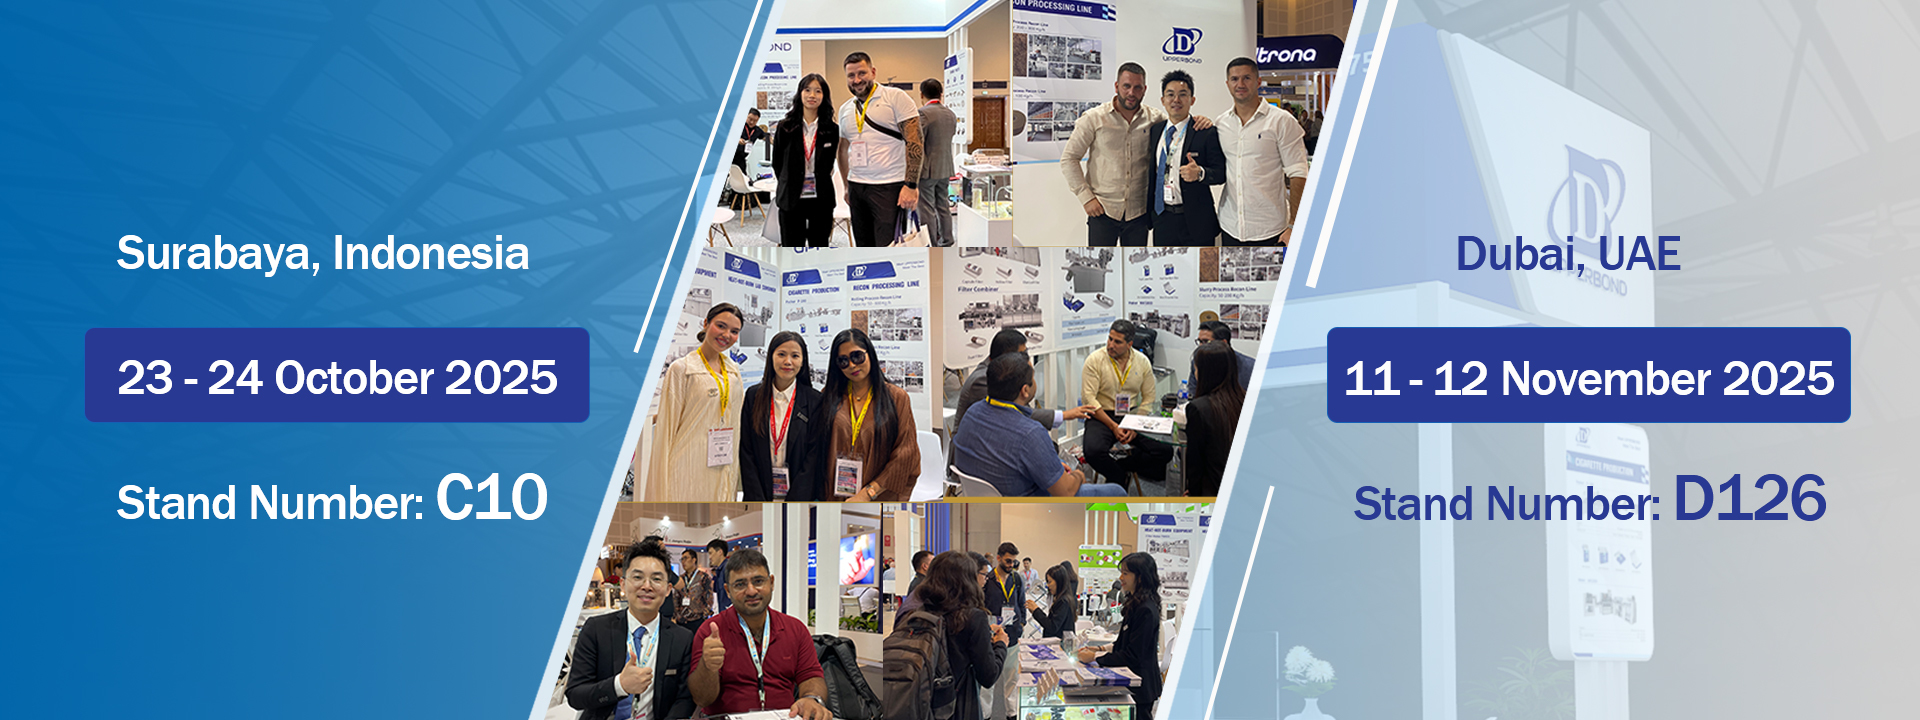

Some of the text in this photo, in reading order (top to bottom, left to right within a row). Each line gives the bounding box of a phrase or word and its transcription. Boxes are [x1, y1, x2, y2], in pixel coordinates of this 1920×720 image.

[1027, 0, 1075, 11] PROCESSING
[1076, 5, 1093, 13] LINE
[1162, 55, 1203, 64] UPPERBOND
[872, 281, 905, 290] PROCESSING
[907, 280, 920, 288] LINE
[811, 286, 840, 294] PRODUCTION
